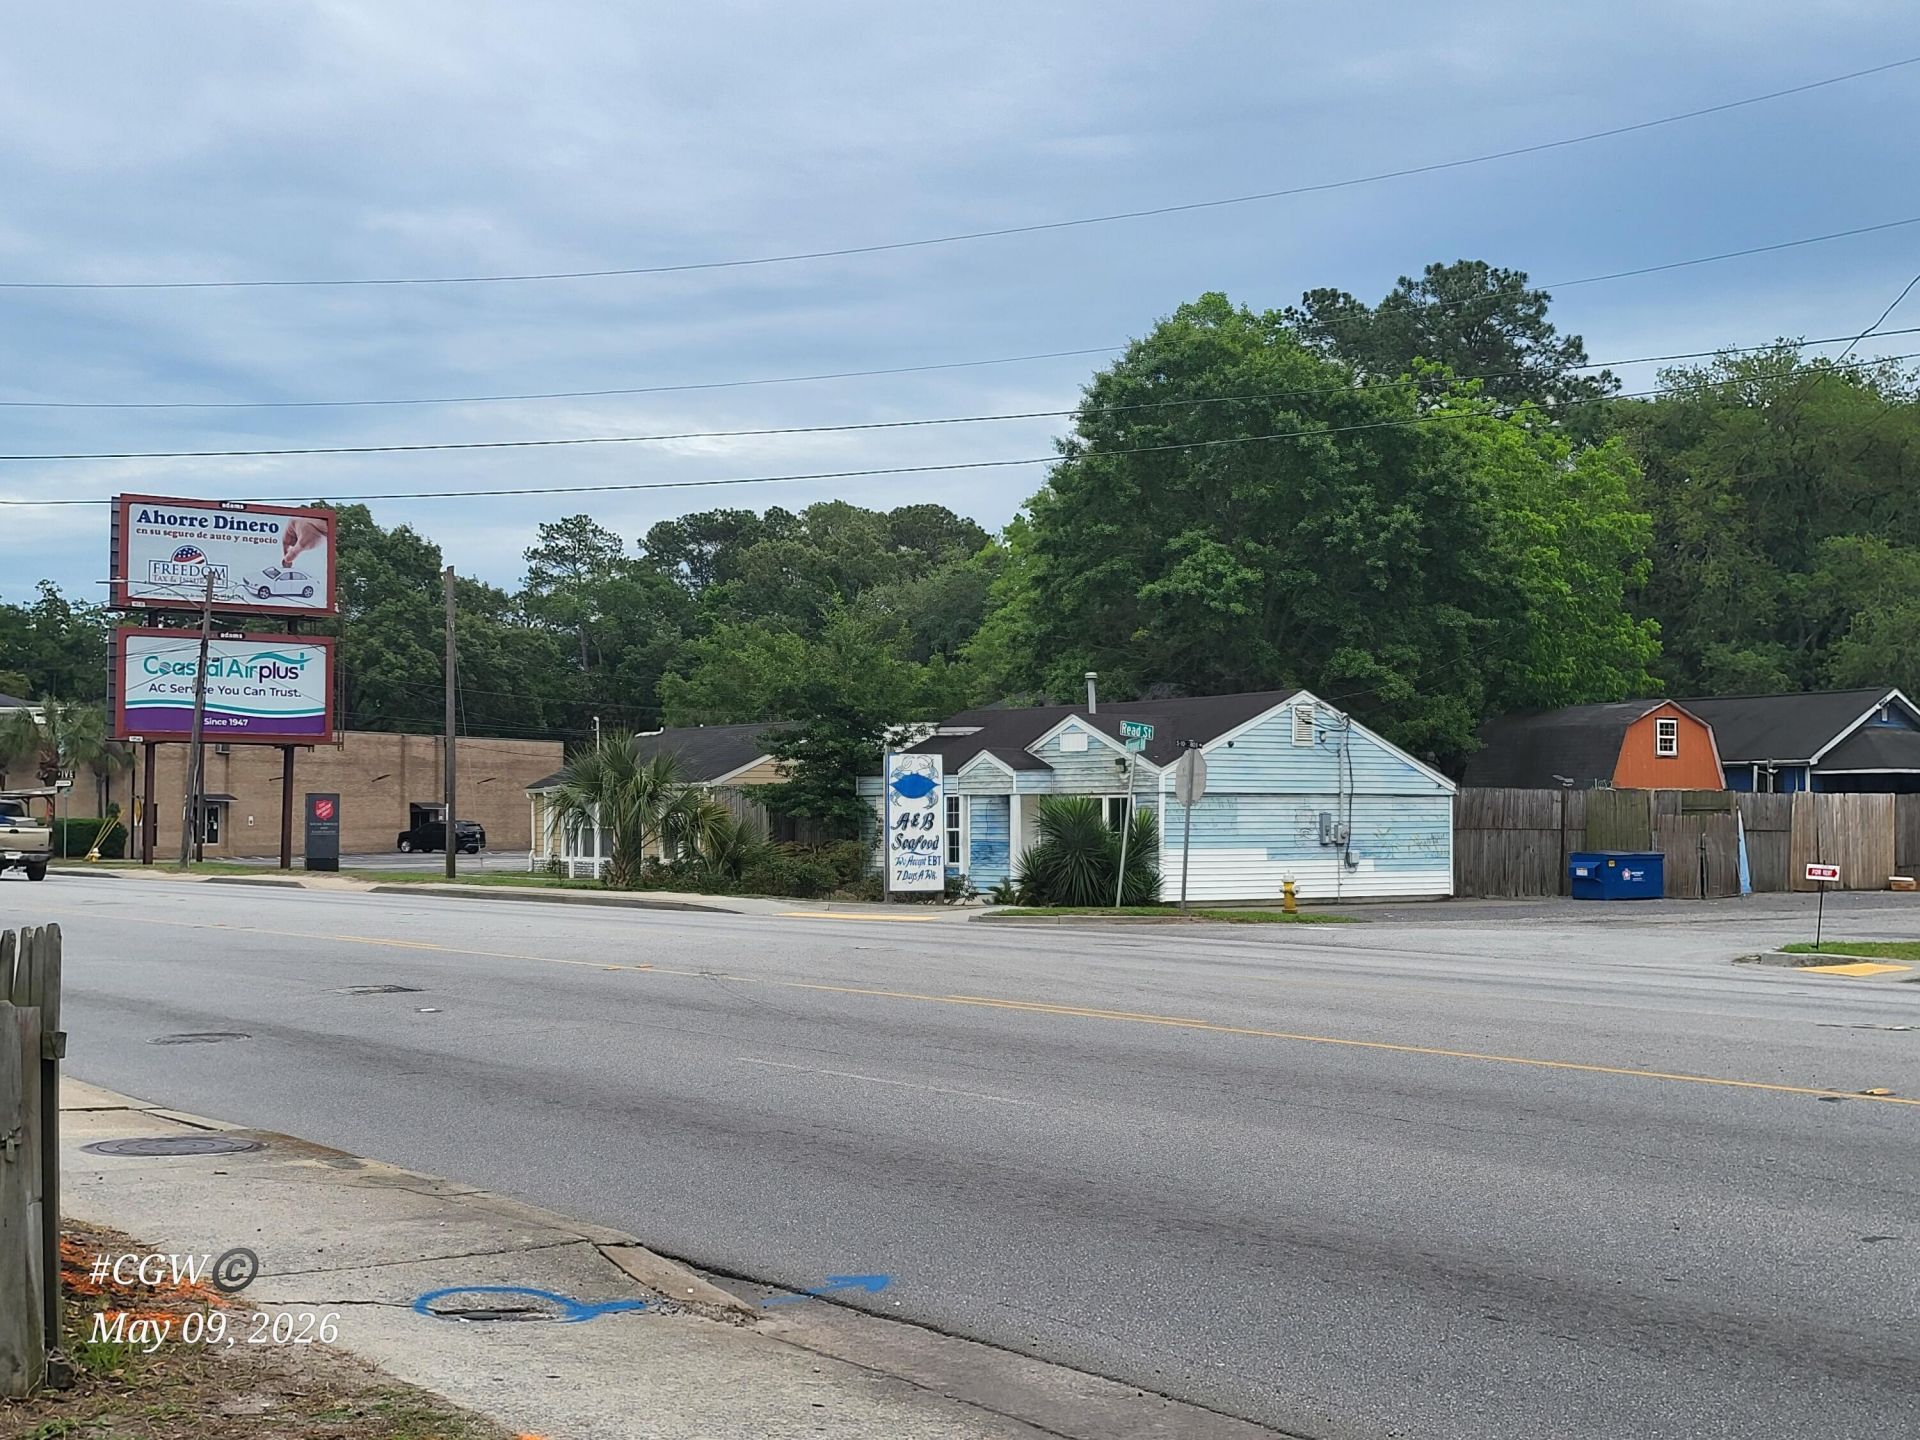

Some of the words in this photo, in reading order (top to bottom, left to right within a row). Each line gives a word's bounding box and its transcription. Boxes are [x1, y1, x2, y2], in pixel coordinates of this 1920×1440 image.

[136, 509, 208, 528] Ahorre
[213, 515, 279, 533] Dinero
[164, 530, 195, 539] seguro
[197, 531, 208, 539] de
[210, 533, 232, 541] auto
[242, 535, 278, 544] negocio
[153, 563, 226, 579] FREEDOM
[153, 574, 168, 582] TAX
[143, 656, 223, 677] Coasal
[149, 683, 166, 693] AC
[217, 685, 240, 696] You
[244, 686, 266, 697] Can
[269, 687, 302, 698] Trust.
[204, 717, 227, 726] Since
[229, 718, 249, 727] 1947
[1121, 722, 1141, 737] Read
[1143, 726, 1152, 739] St
[891, 833, 940, 851] Seafood
[928, 855, 941, 866] EBT
[896, 870, 902, 880] 7
[902, 870, 918, 884] Days
